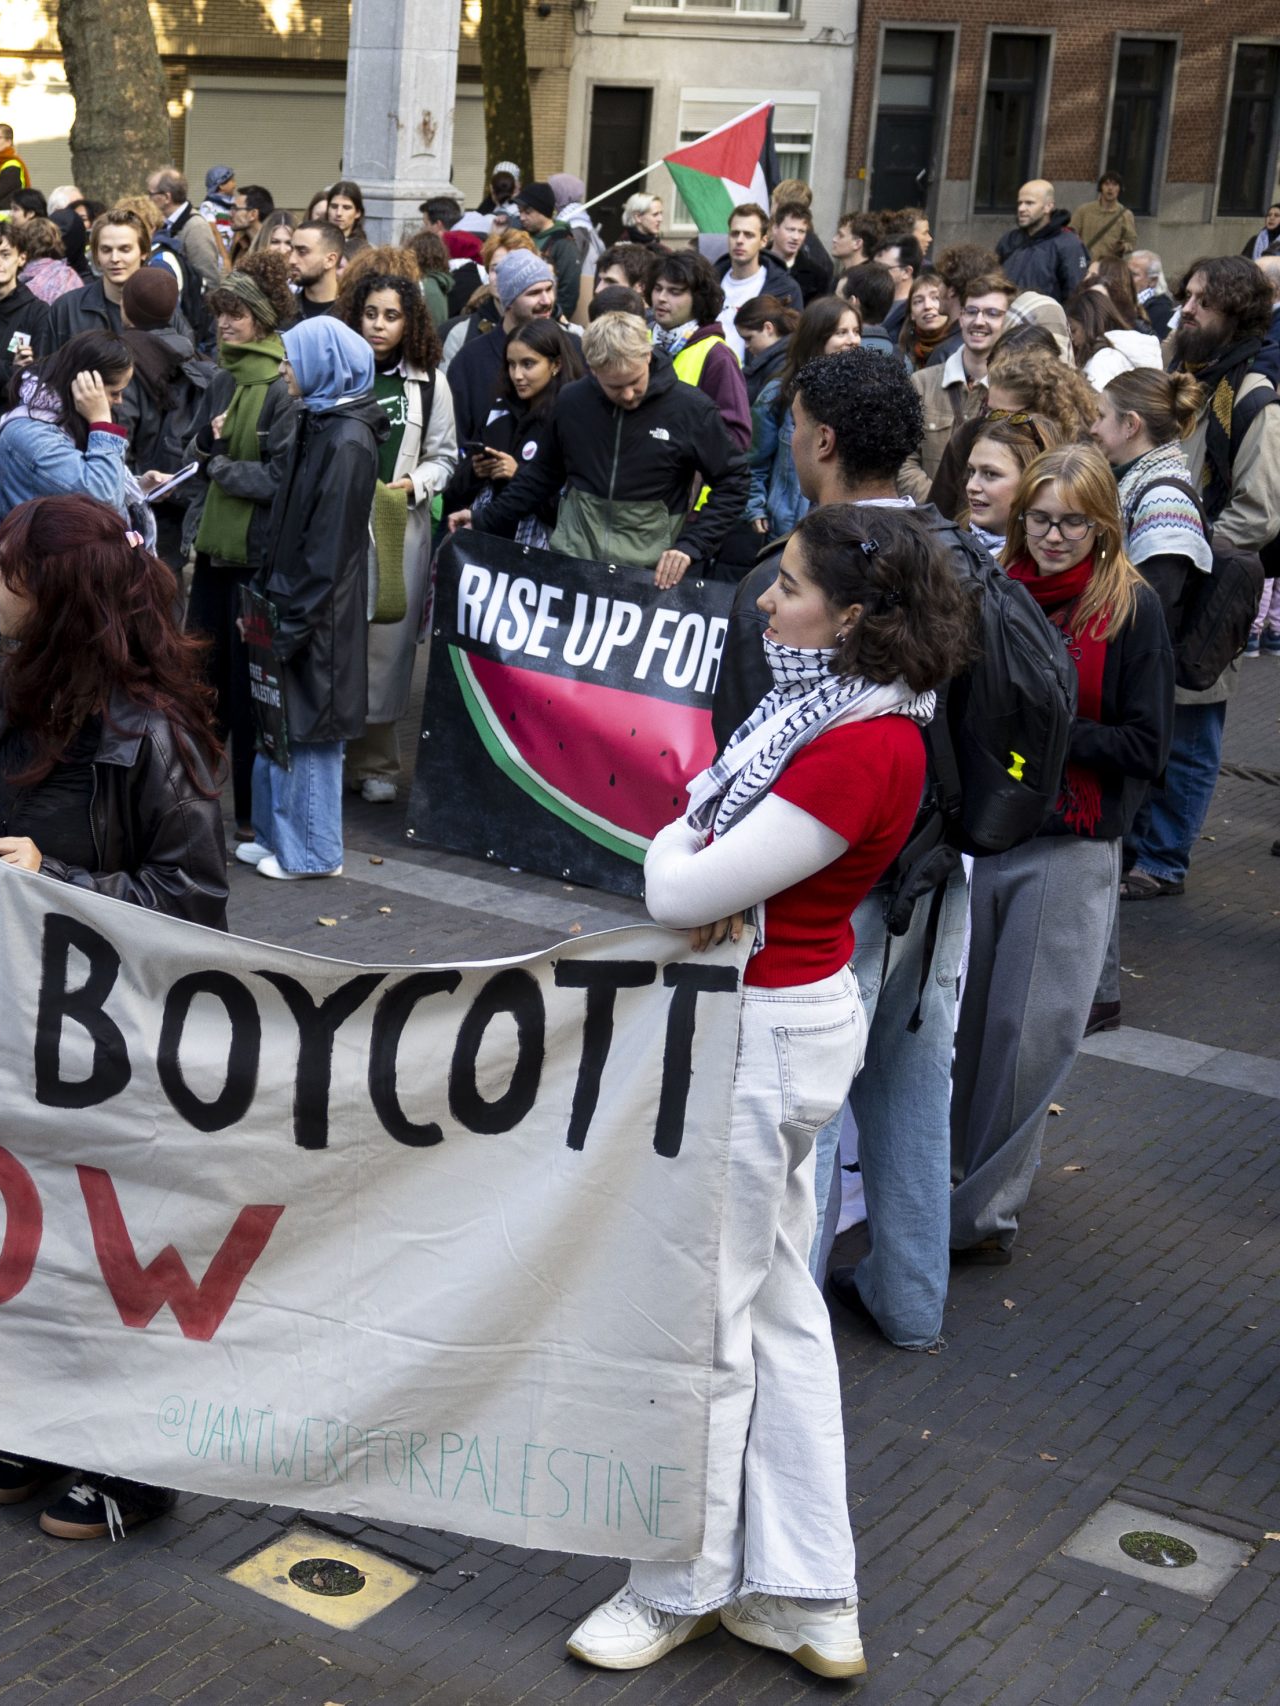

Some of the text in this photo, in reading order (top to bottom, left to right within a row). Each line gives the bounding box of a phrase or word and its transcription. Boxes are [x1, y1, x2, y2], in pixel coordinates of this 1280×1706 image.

[456, 562, 564, 658] RISE
[562, 592, 642, 672] UP
[632, 607, 729, 695] FOR
[249, 662, 263, 682] FREE
[250, 680, 281, 708] PALESTINE
[34, 911, 739, 1158] BOYCOTT
